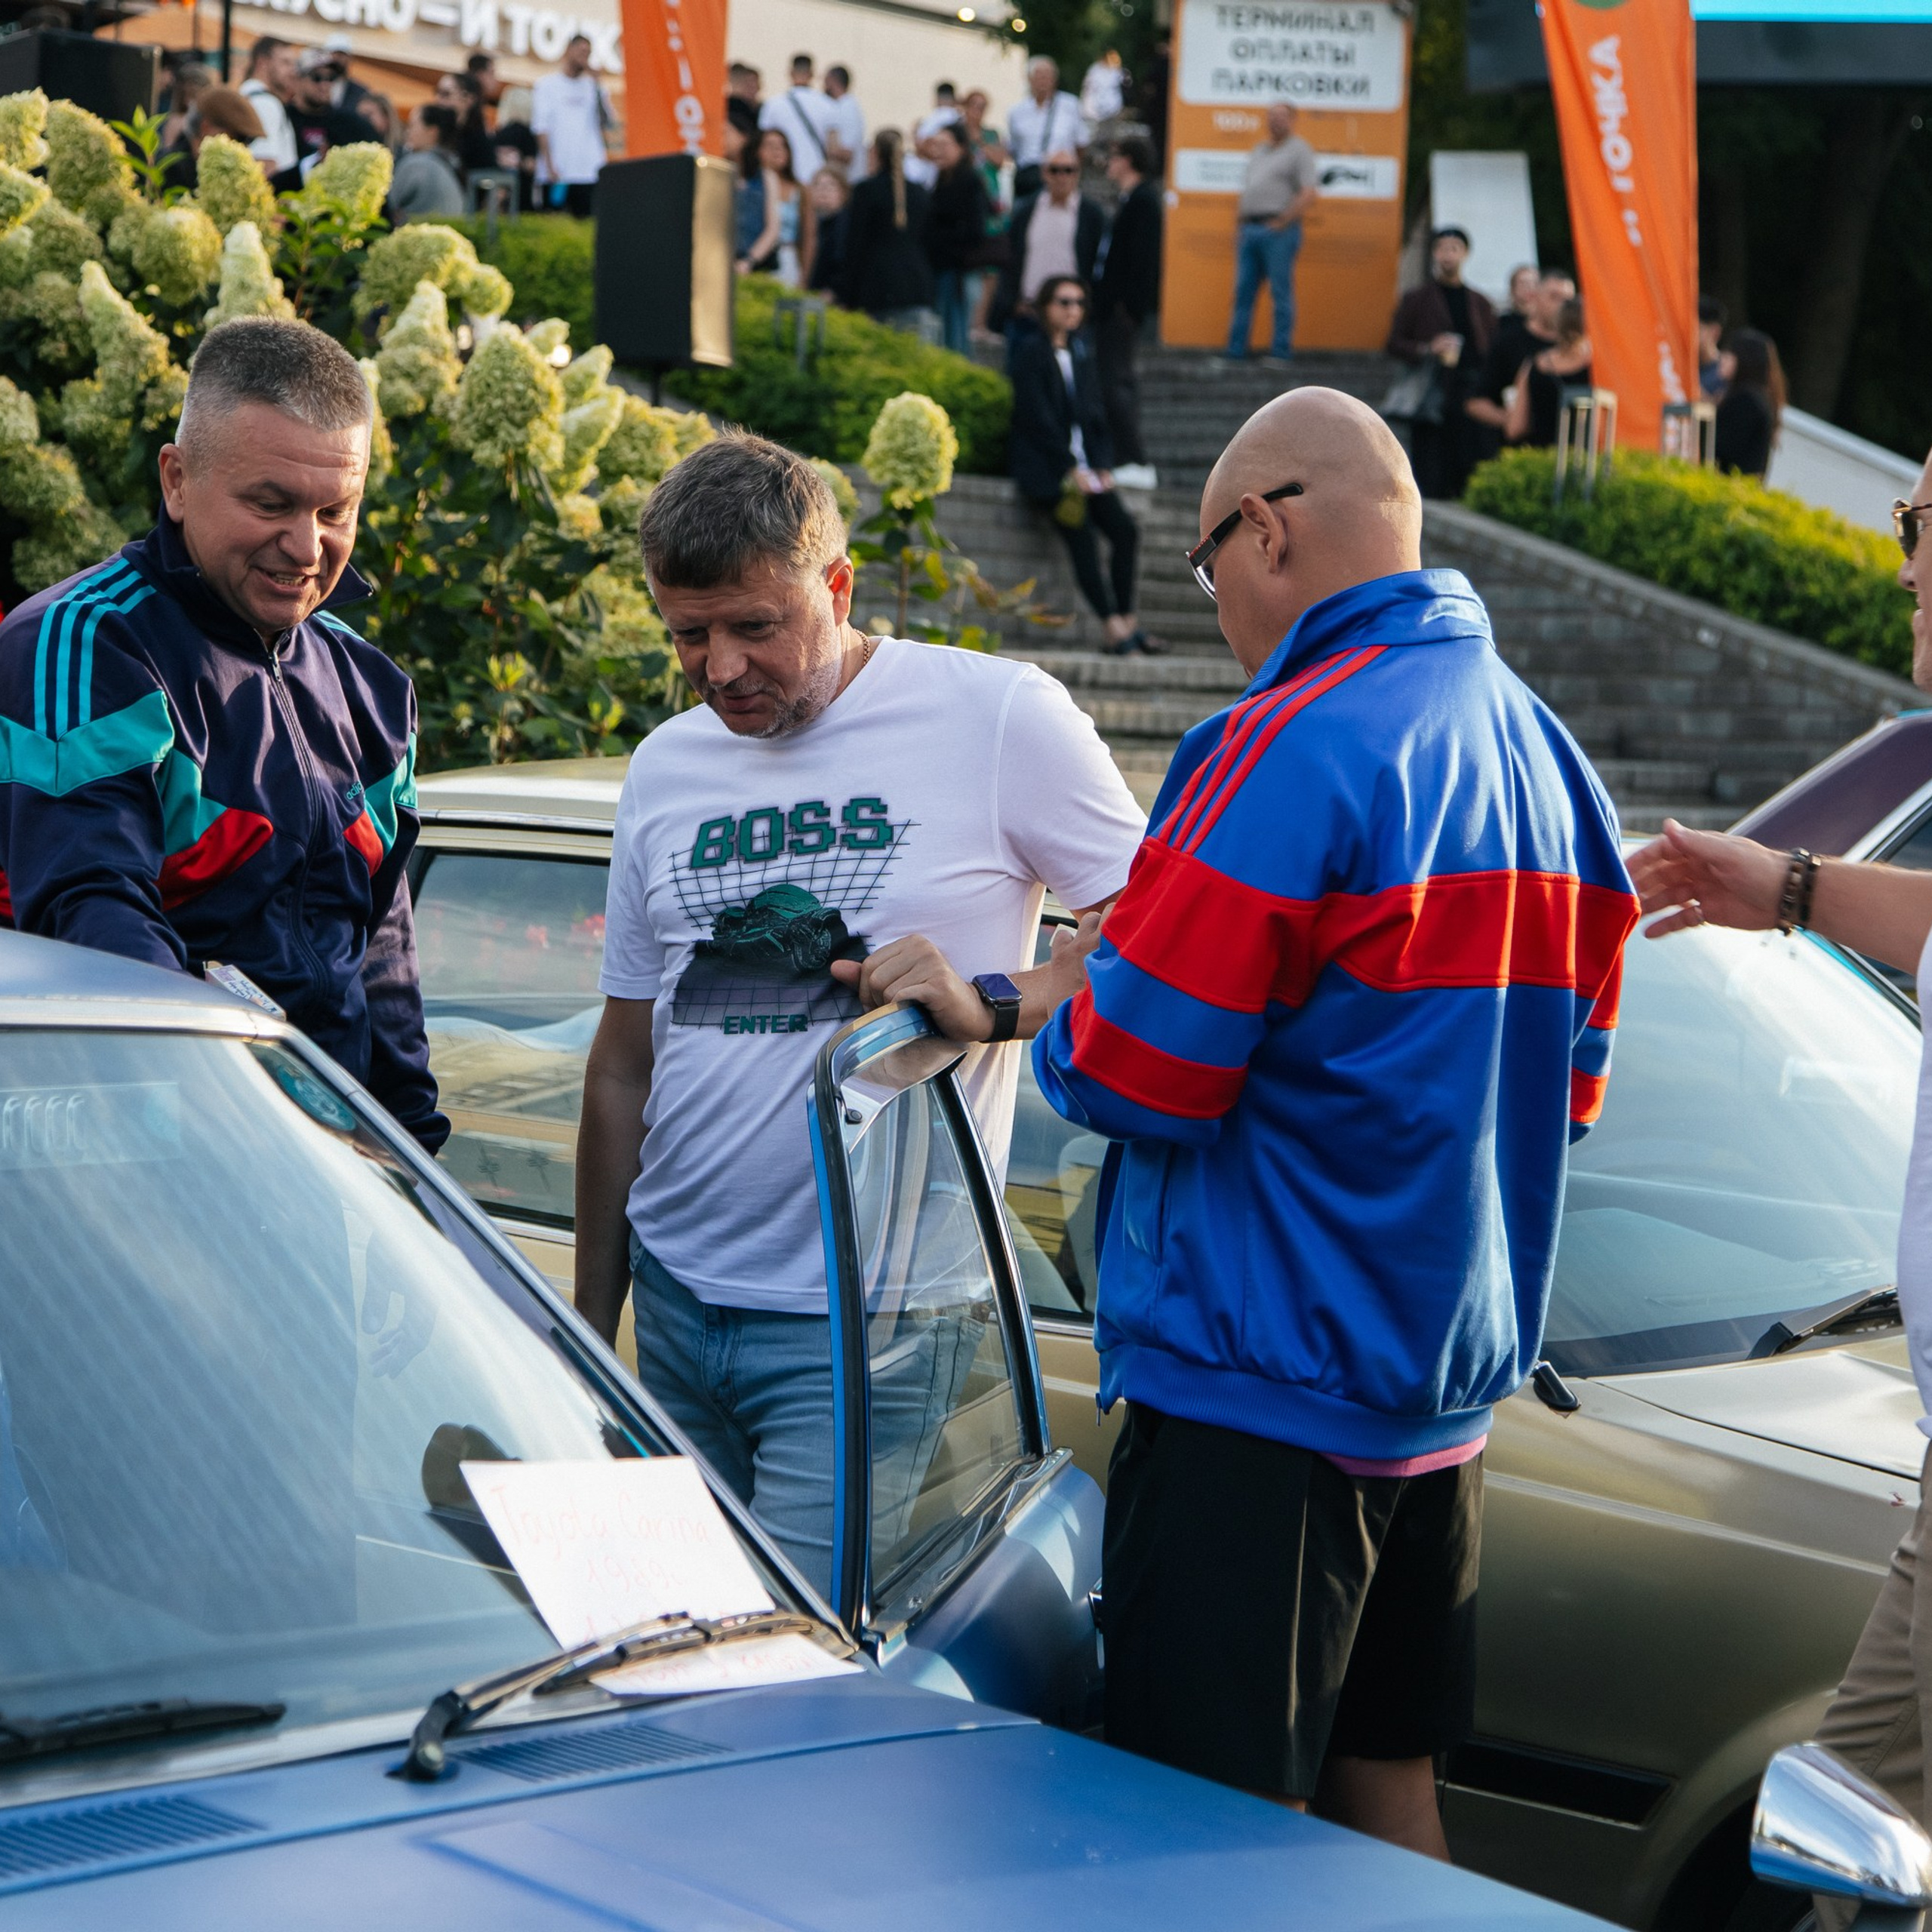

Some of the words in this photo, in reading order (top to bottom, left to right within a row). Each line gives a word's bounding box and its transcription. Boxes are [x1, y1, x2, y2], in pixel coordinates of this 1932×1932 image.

[1216, 3, 1375, 33] ТЕРМИНАЛ
[1229, 37, 1356, 66] ОПЛАТЫ
[1211, 68, 1371, 98] ПАРКОВКИ
[346, 780, 364, 800] adid
[689, 797, 894, 870] BOSS
[723, 1014, 810, 1035] ENTER
[488, 1482, 610, 1562] Toyota
[617, 1487, 711, 1546] Carina
